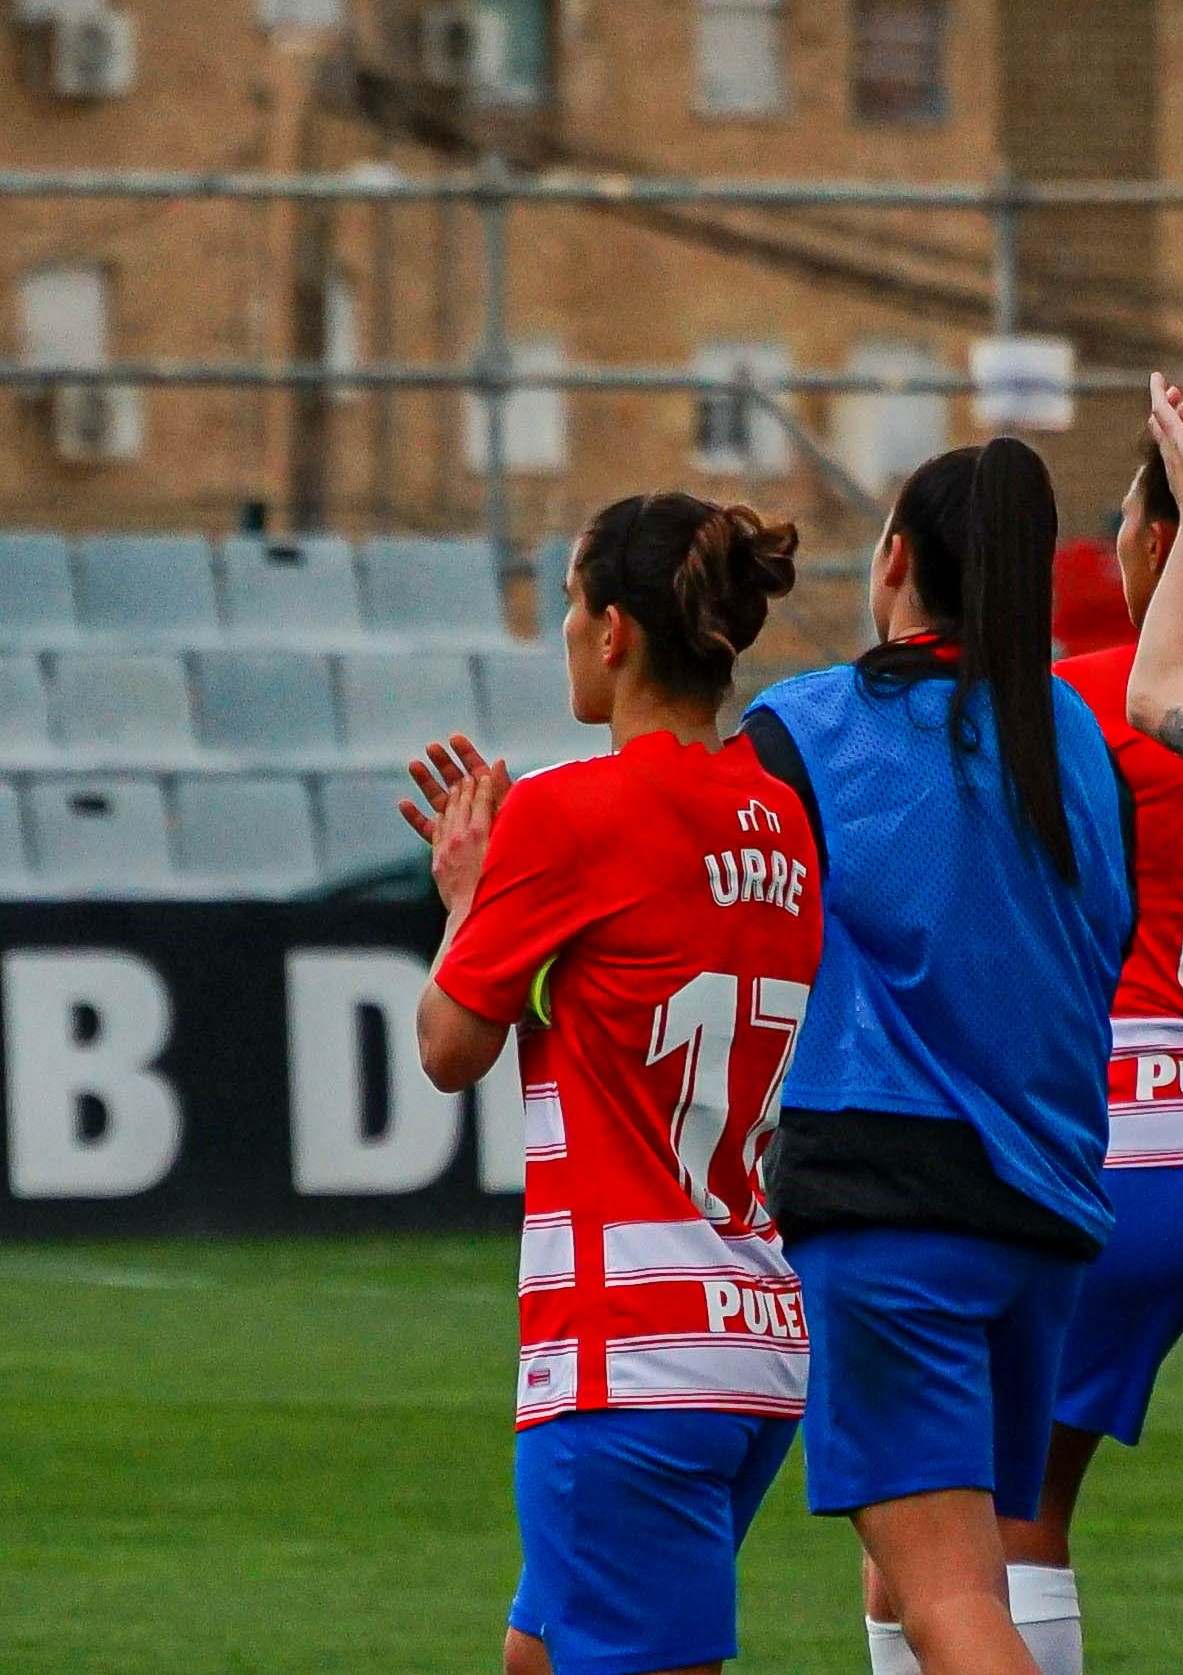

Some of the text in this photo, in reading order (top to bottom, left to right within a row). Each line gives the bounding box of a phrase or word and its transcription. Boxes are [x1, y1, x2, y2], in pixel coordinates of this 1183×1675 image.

[703, 848, 807, 917] URRE
[2, 945, 184, 1199] B
[645, 971, 811, 1227] 17
